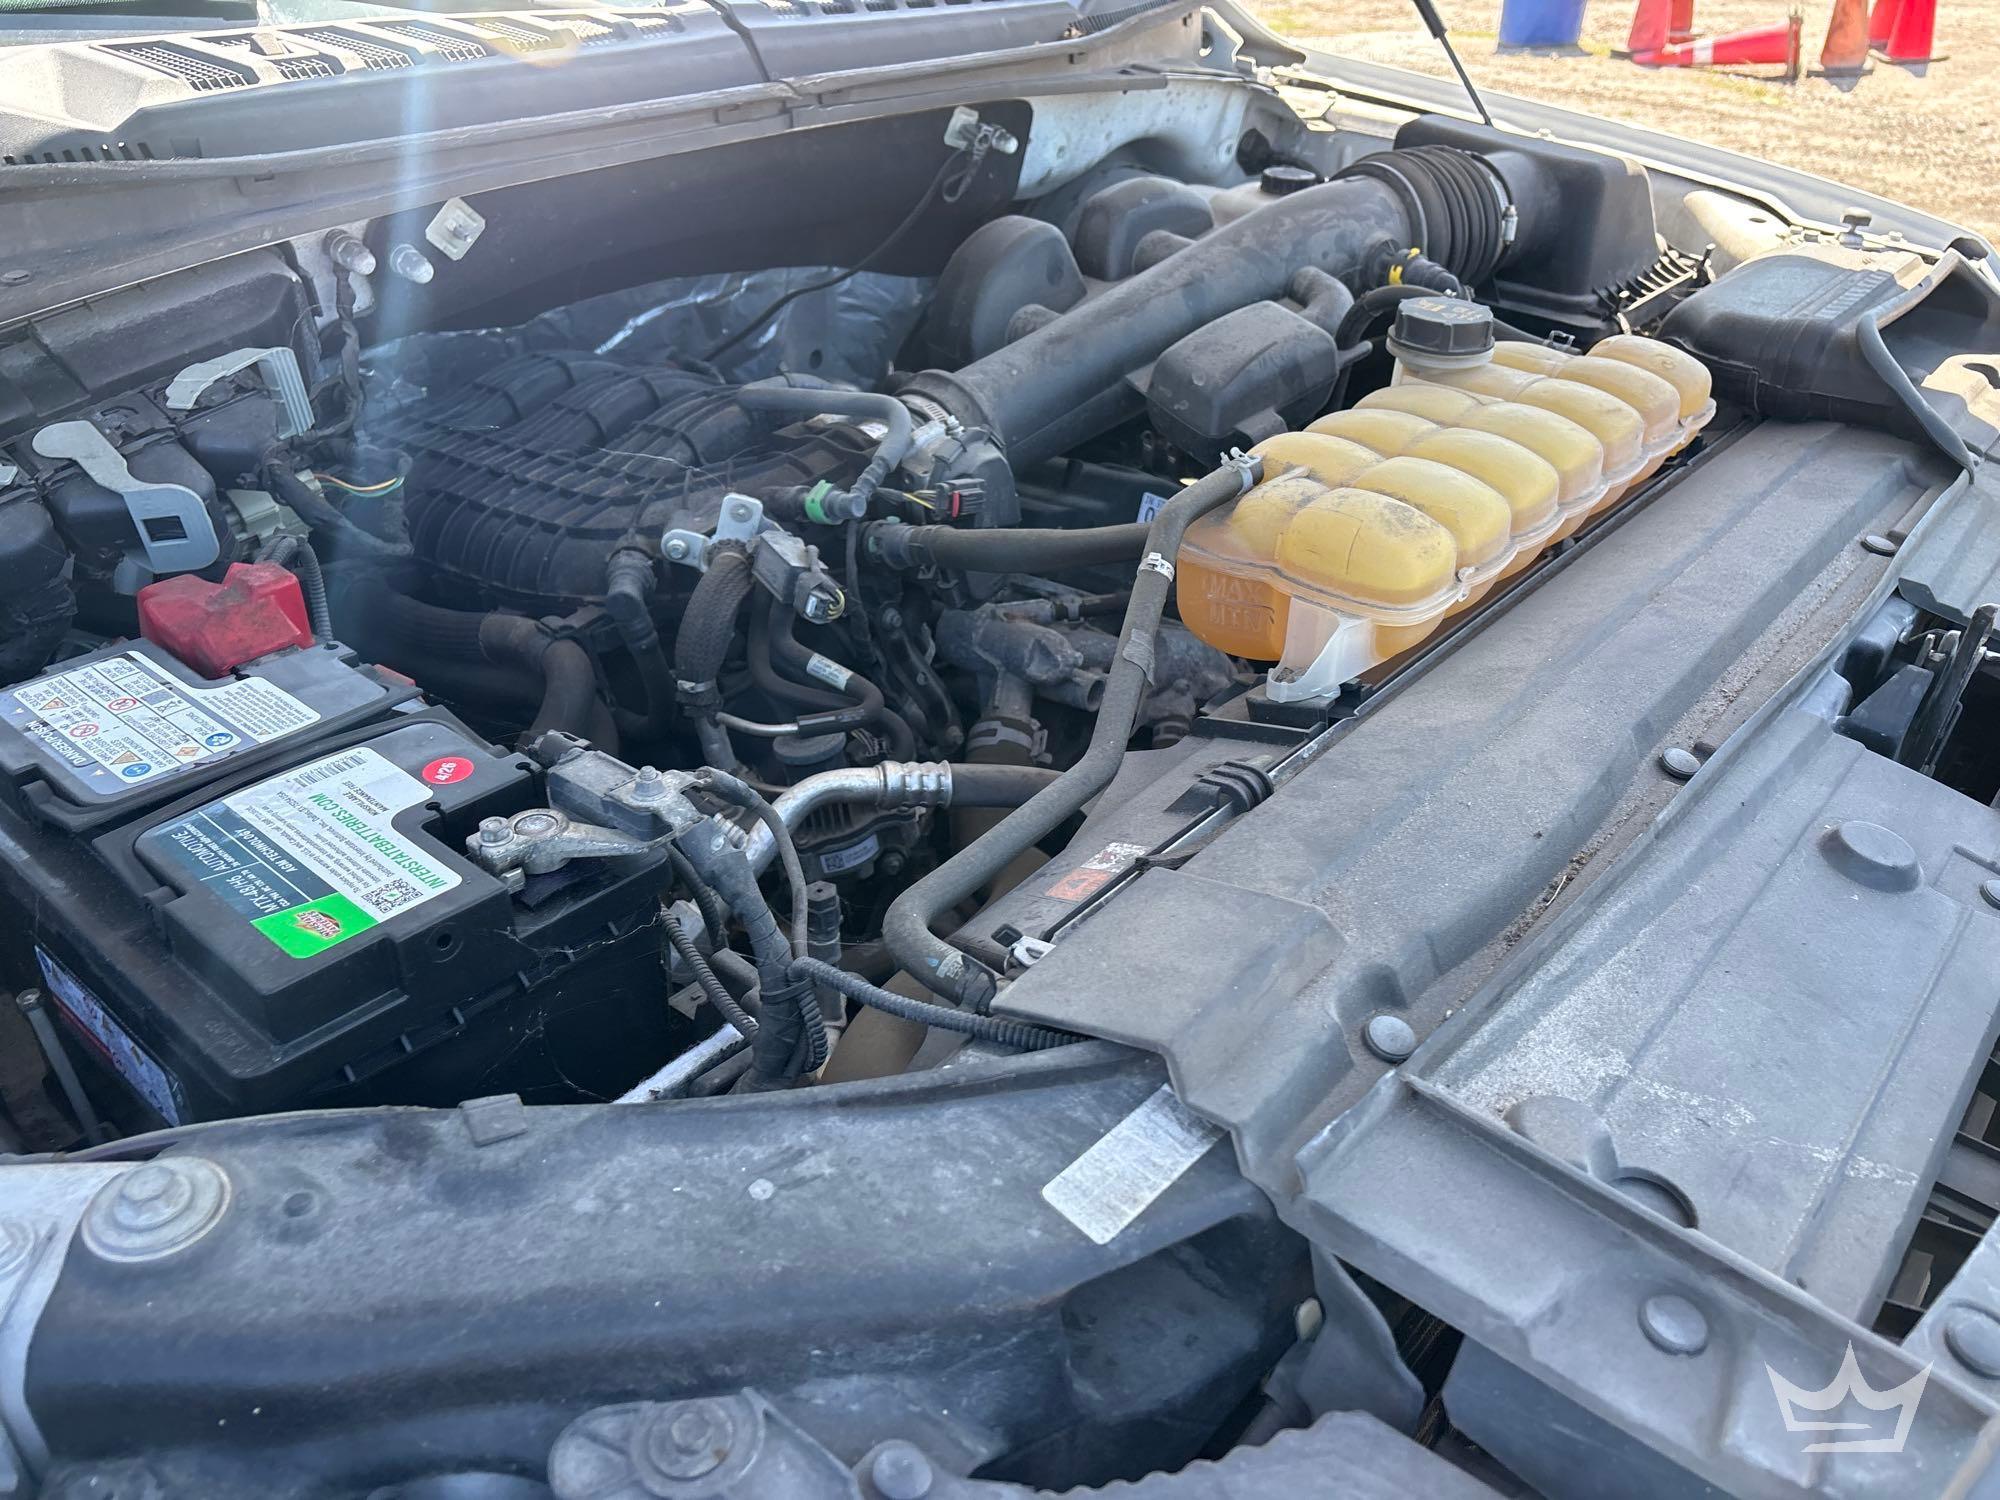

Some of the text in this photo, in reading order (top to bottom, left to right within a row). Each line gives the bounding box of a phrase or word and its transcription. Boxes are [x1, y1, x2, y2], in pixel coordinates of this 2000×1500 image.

[1209, 574, 1263, 601] MAX
[24, 719, 88, 764] DANGER/POISON
[434, 762, 458, 781] 4/26
[341, 790, 380, 817] NONSPILLABLE
[352, 787, 390, 812] MAINTENANCE
[170, 828, 231, 873] AUTOMOTIVE
[233, 825, 299, 874] AGM TECHNOLOGY
[306, 791, 450, 890] INTERSTATEBATTERIES.COM
[224, 873, 280, 913] MTX-48/H6
[294, 911, 334, 937] INTERSTATE
